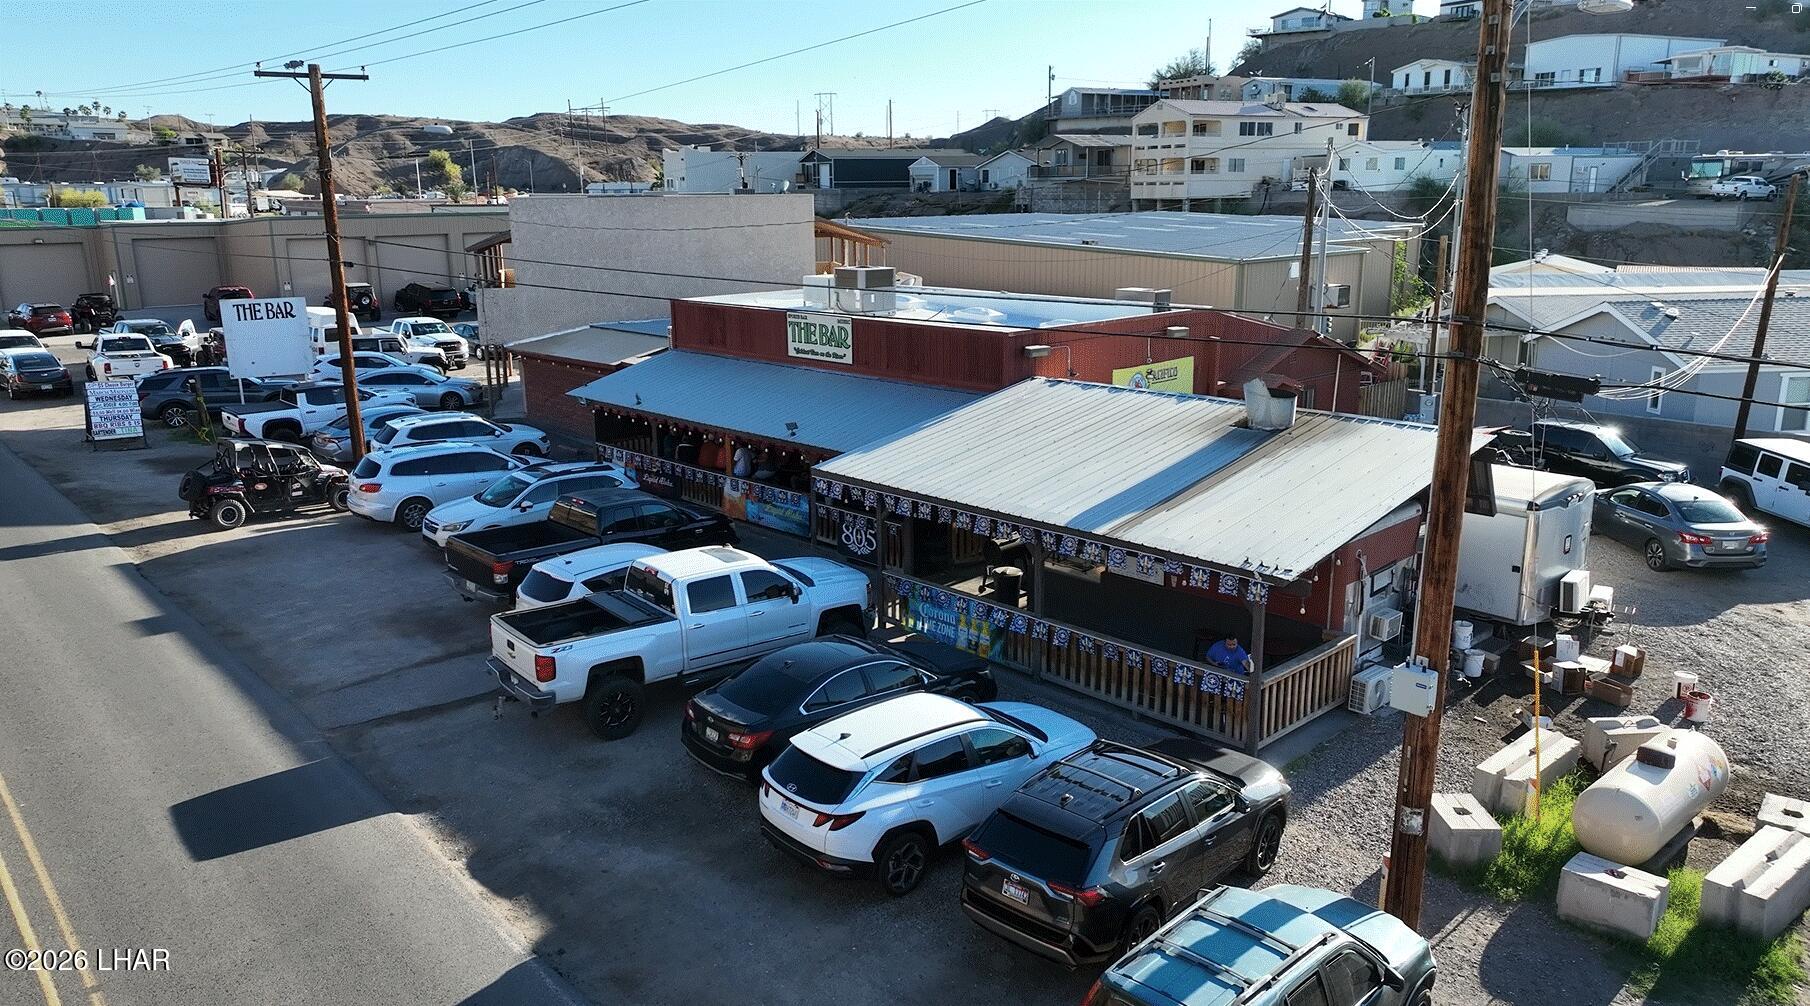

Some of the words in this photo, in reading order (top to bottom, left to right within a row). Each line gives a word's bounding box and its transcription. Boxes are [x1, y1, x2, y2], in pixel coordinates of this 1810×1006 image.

[233, 303, 263, 321] THE
[265, 302, 296, 319] BAR
[788, 321, 818, 345] THE
[819, 324, 851, 349] BAR
[95, 394, 133, 402] WEDNESDAY
[100, 414, 133, 422] THURSDAY
[841, 520, 877, 551] 805
[920, 602, 956, 625] Corona
[937, 622, 955, 638] ZONE
